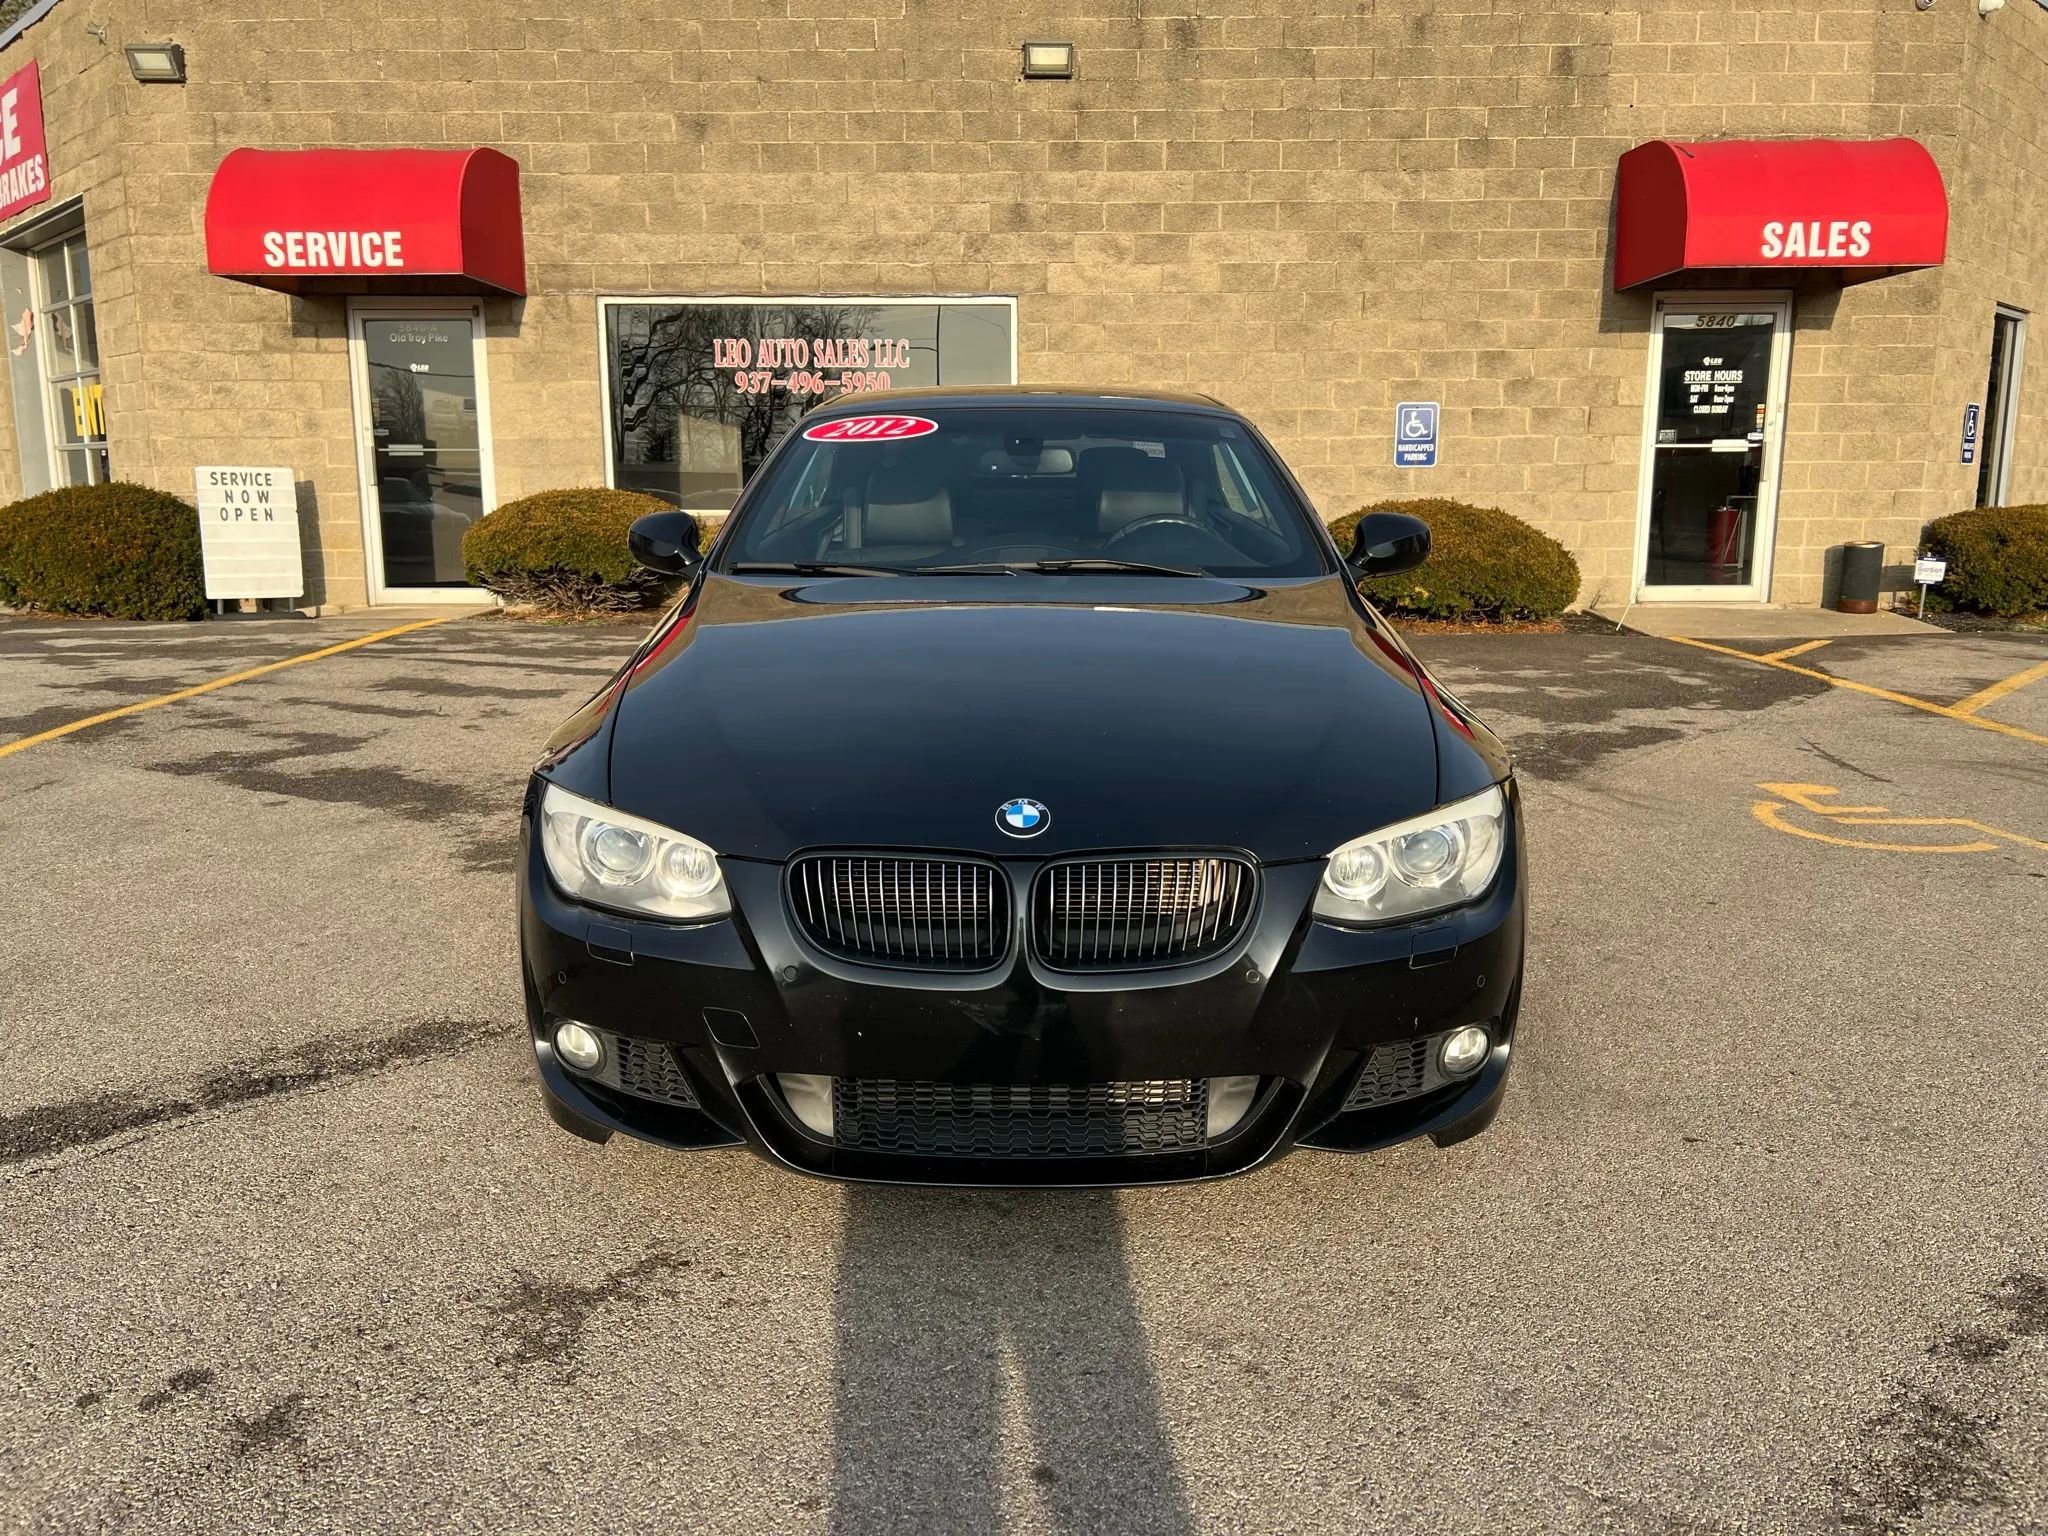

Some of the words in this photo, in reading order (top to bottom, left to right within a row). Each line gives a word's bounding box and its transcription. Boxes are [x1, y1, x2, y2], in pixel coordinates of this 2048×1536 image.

[0, 154, 46, 209] RAKES
[1761, 220, 1872, 259] SALES
[263, 231, 404, 267] SERVICE
[1696, 315, 1735, 327] 5840
[390, 333, 406, 342] Old
[408, 333, 426, 344] Troy
[428, 333, 448, 342] Pike
[713, 338, 752, 368] LEO
[756, 338, 809, 368] AUTO
[813, 338, 869, 368] SALES
[873, 338, 911, 368] LLC
[734, 371, 891, 394] 937-496-5950
[1684, 370, 1712, 381] STORE
[1714, 370, 1743, 381] HOURS
[1693, 405, 1710, 413] CLOSED
[822, 419, 917, 437] 2012
[1404, 453, 1427, 461] PARKING
[210, 471, 273, 487] SERVICE
[224, 489, 269, 504] NOW
[219, 507, 273, 522] OPEN
